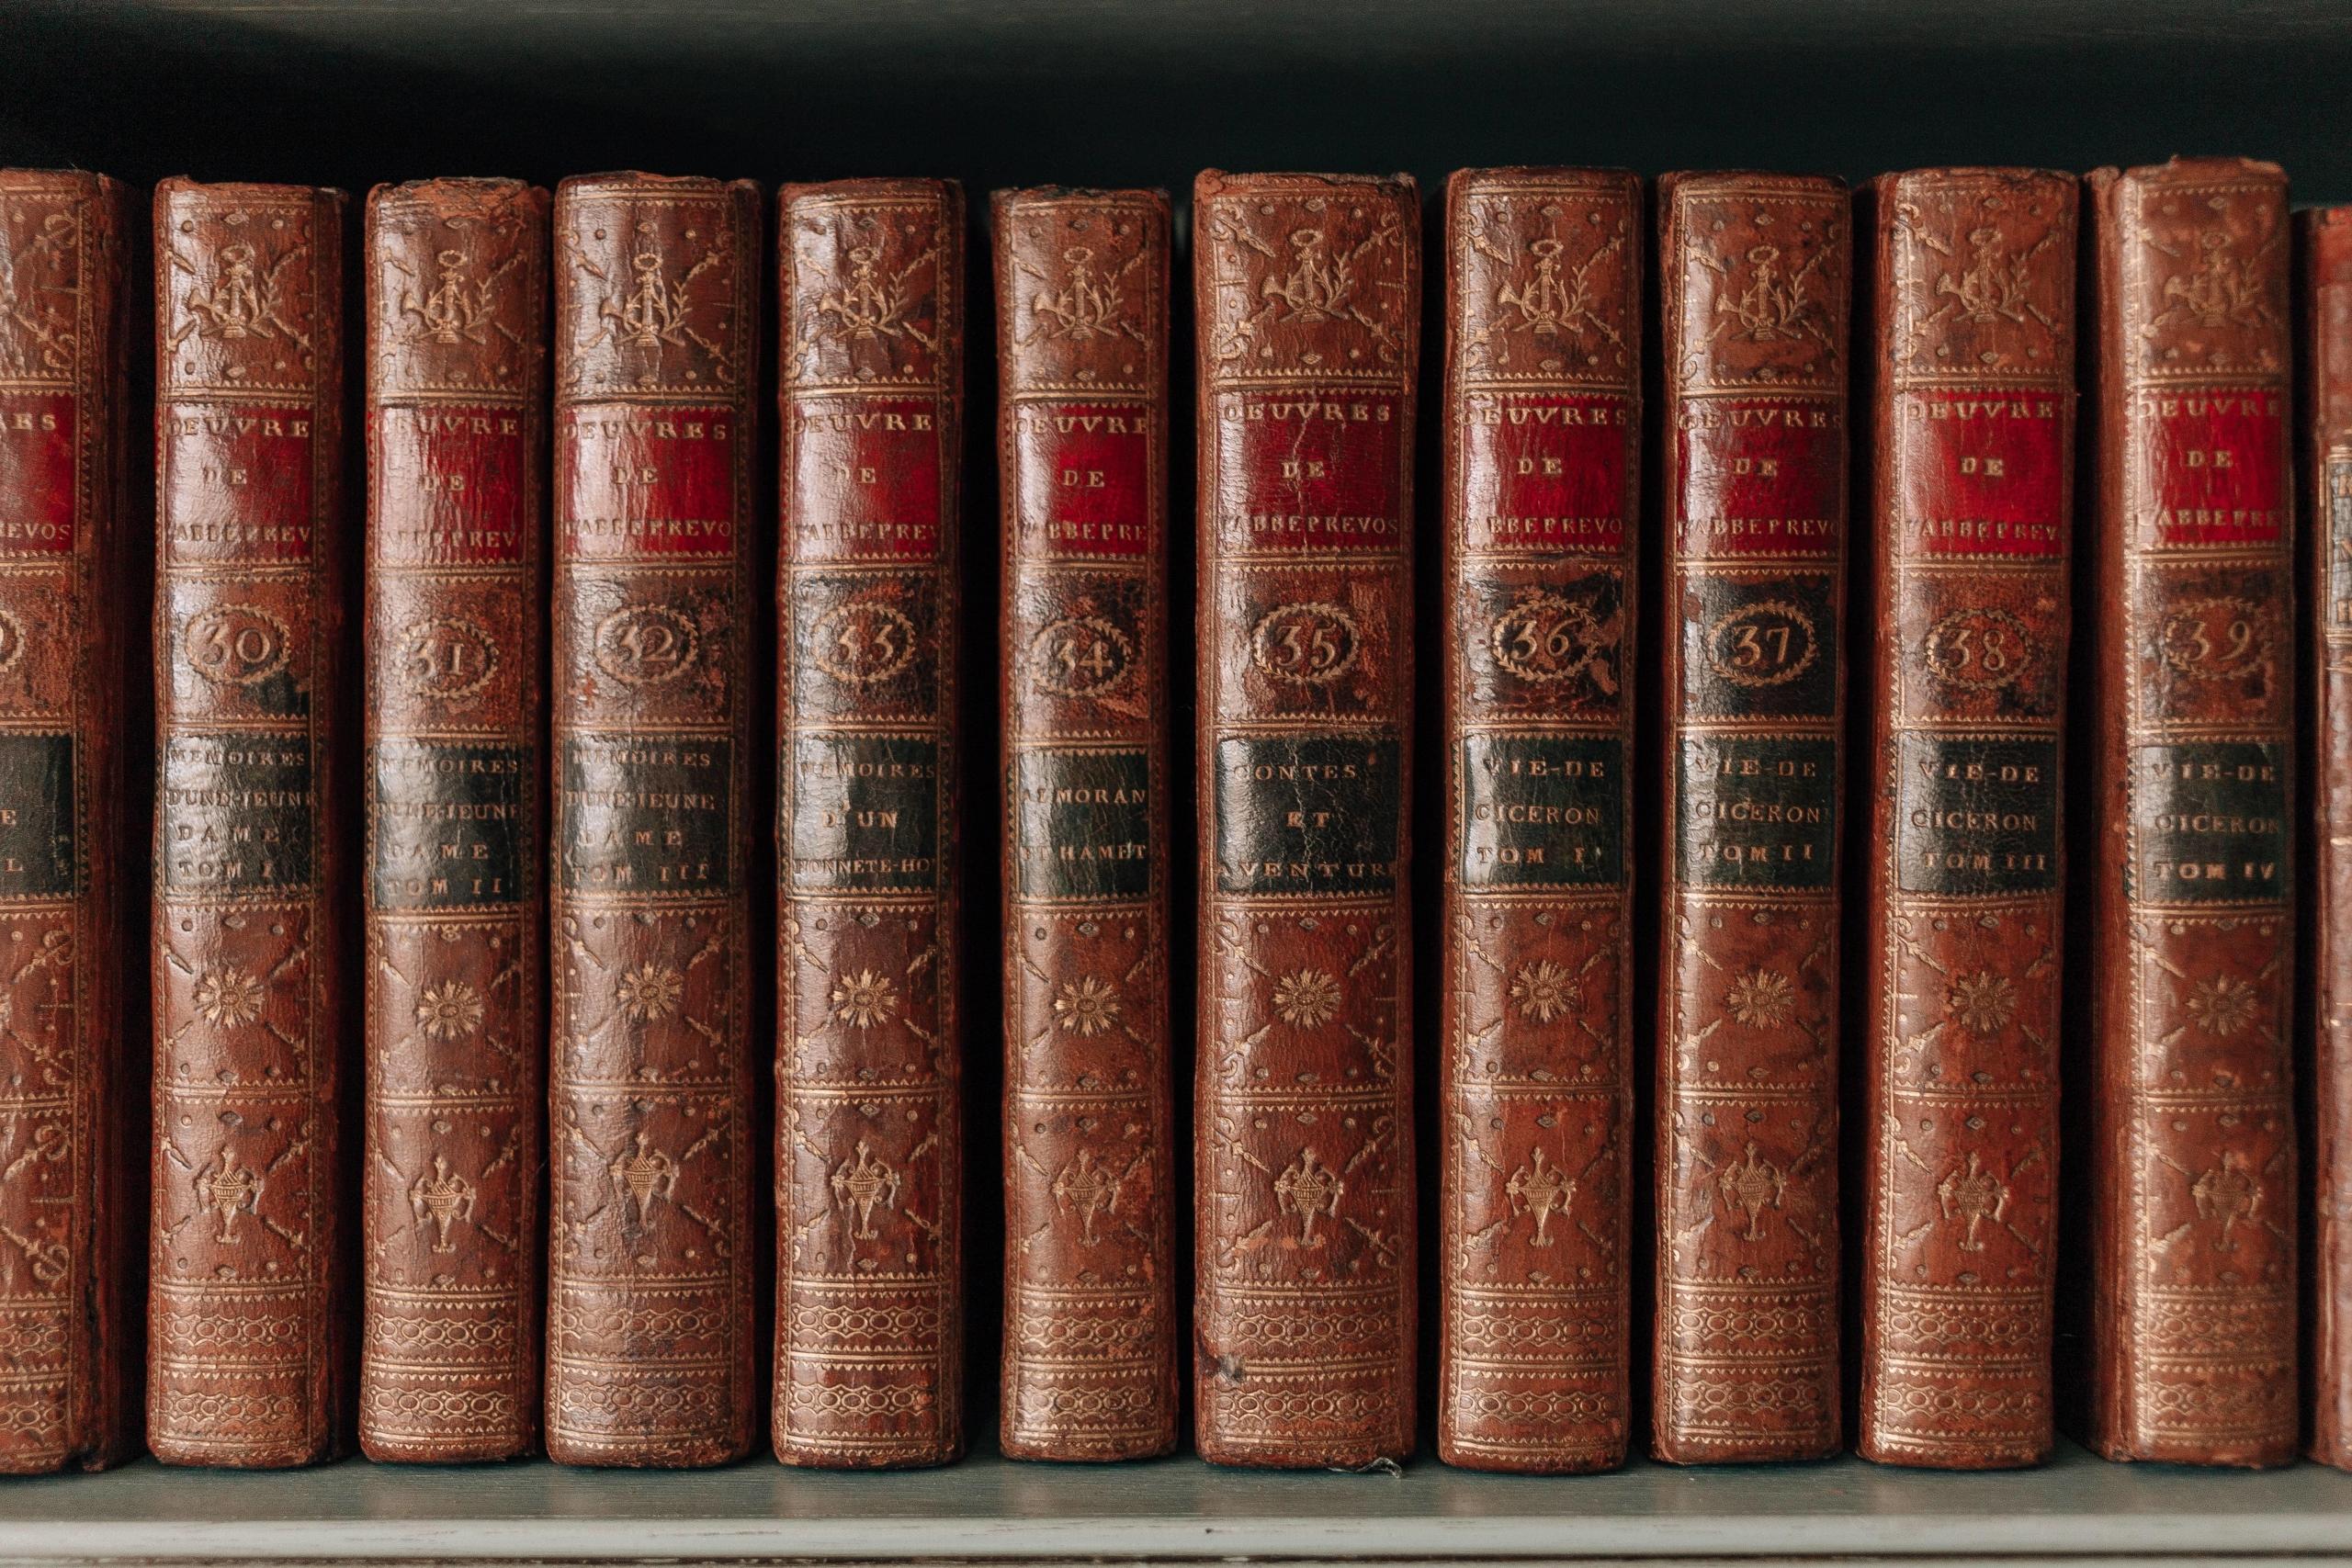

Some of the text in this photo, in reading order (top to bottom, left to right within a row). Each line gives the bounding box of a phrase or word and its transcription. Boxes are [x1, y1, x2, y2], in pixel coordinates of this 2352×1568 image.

[1225, 402, 1390, 422] OEUVRES
[0, 412, 56, 433] ES
[1516, 457, 1562, 475] DE
[1959, 457, 2004, 476] DE
[2187, 450, 2233, 468] DE
[614, 467, 659, 484] DE
[1062, 469, 1105, 488] DE
[1281, 461, 1325, 479] DE
[201, 623, 271, 665] 30
[616, 624, 677, 662] 32
[830, 625, 895, 664] 33
[1275, 624, 1337, 668] 35
[1510, 618, 1580, 660] 36
[1732, 626, 1790, 667] 37
[2181, 620, 2251, 661] 39
[407, 639, 464, 677] 31
[1049, 638, 1114, 677] 34
[1945, 628, 2006, 671] 38
[1234, 763, 1358, 780] CONTES
[1286, 810, 1330, 829] ET
[1475, 804, 1602, 824] CICERON
[1695, 801, 1820, 823] CICERON
[1910, 809, 2037, 831] CICERON
[2154, 814, 2279, 834] CICERON
[177, 827, 279, 842] DAME
[1059, 844, 1147, 862] HAMET
[1476, 846, 1544, 865] TOM
[1700, 844, 1815, 863] TOM II
[1923, 852, 2046, 871] TOM III
[179, 861, 242, 878] TOM
[572, 863, 633, 883] TOM
[2154, 861, 2276, 881] TOM IV
[387, 878, 503, 897] TOM II
